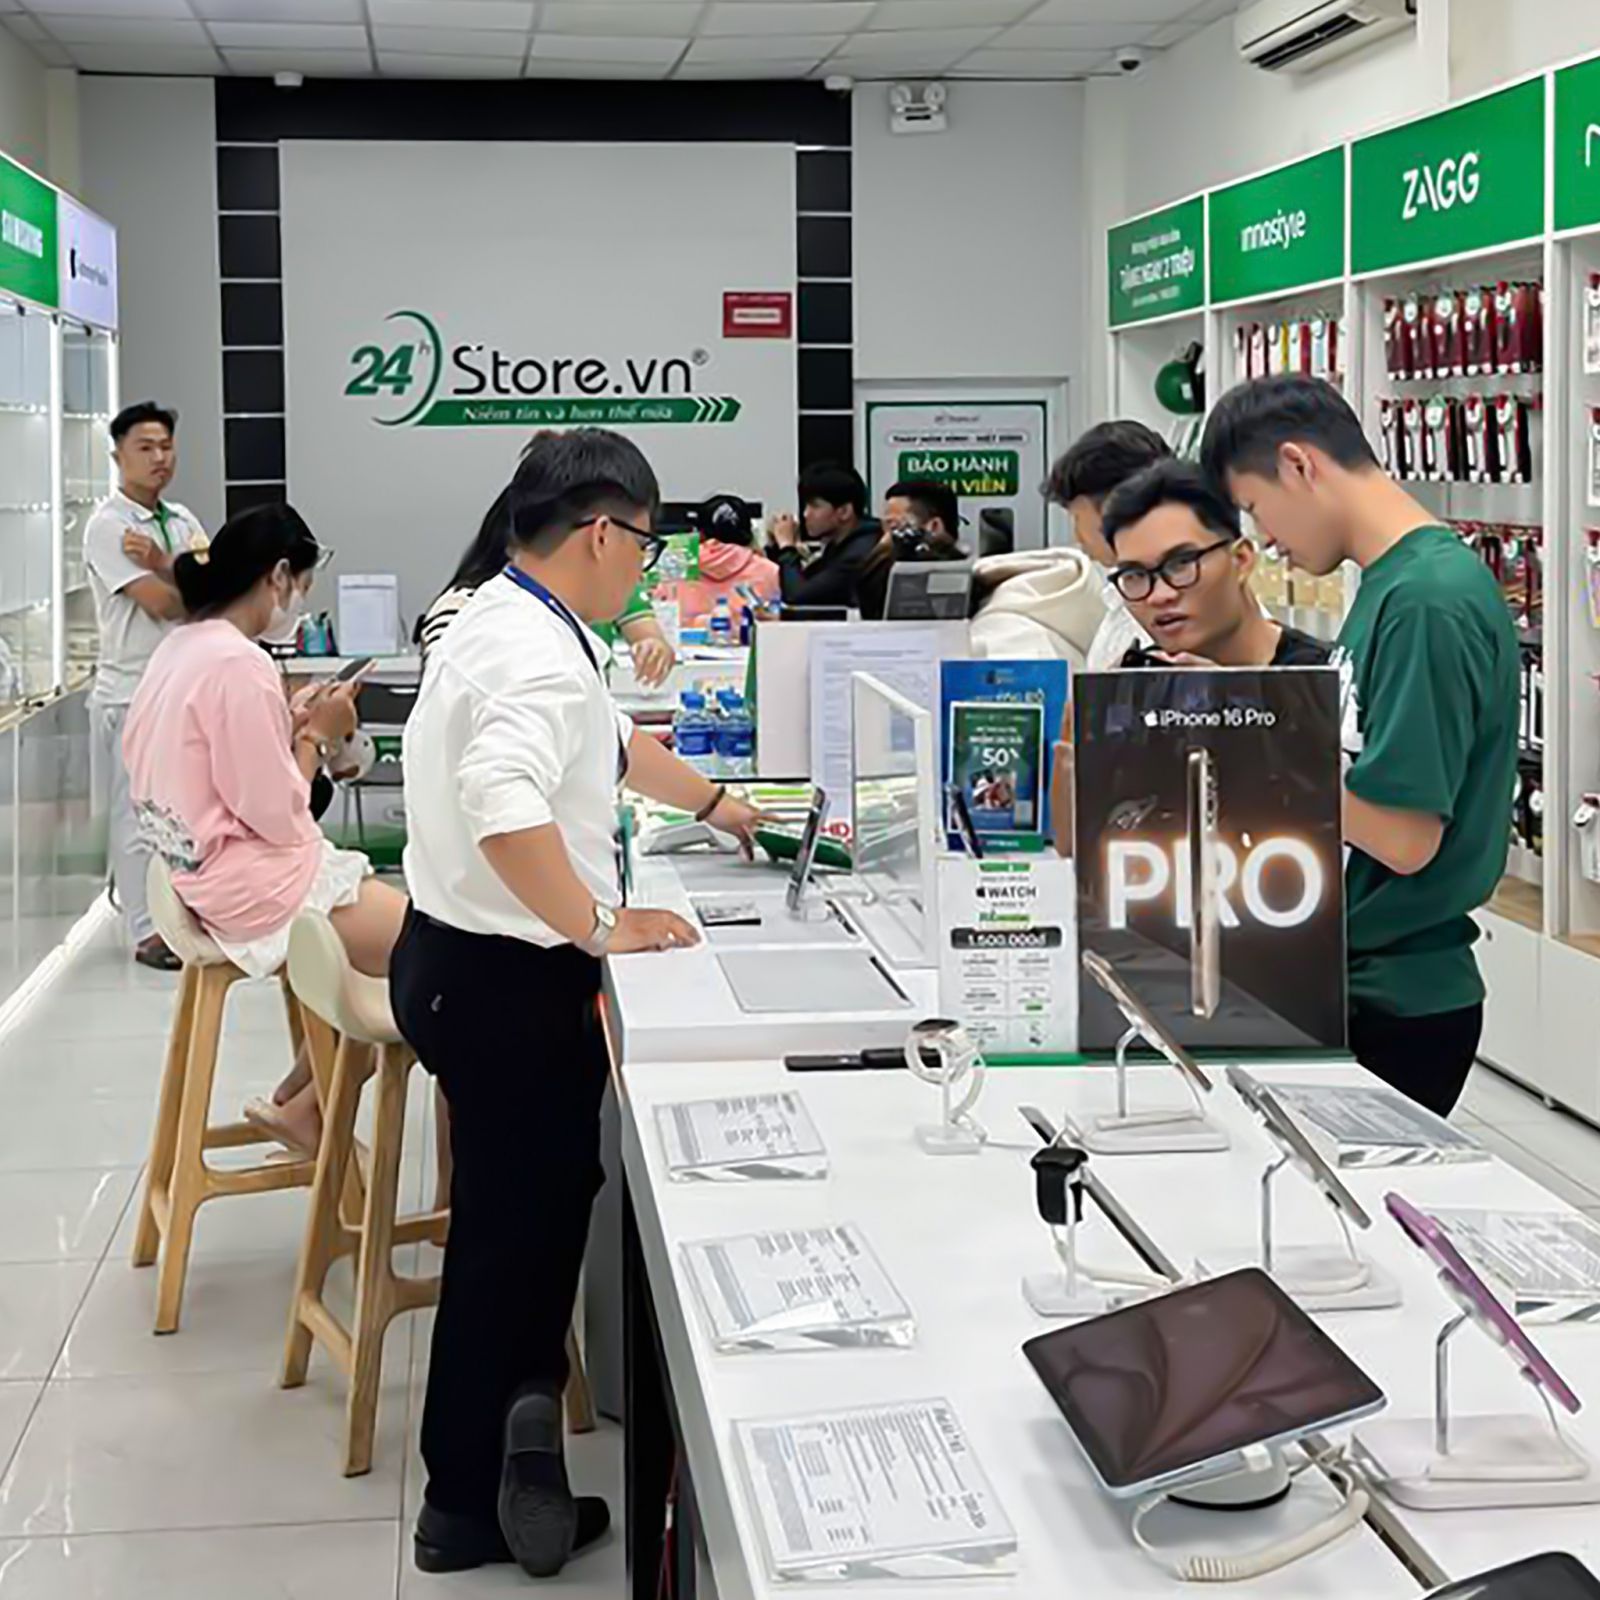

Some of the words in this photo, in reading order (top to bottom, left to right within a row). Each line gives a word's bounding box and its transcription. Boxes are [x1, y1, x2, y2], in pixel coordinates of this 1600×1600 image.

[1402, 151, 1480, 220] ZAGG
[907, 451, 949, 473] BẢO
[952, 455, 1009, 473] HÀNH
[1160, 708, 1221, 726] iPhone
[1223, 708, 1243, 726] 16
[1245, 708, 1276, 726] Pro
[988, 886, 1036, 899] WATCH
[1108, 836, 1323, 930] PRO
